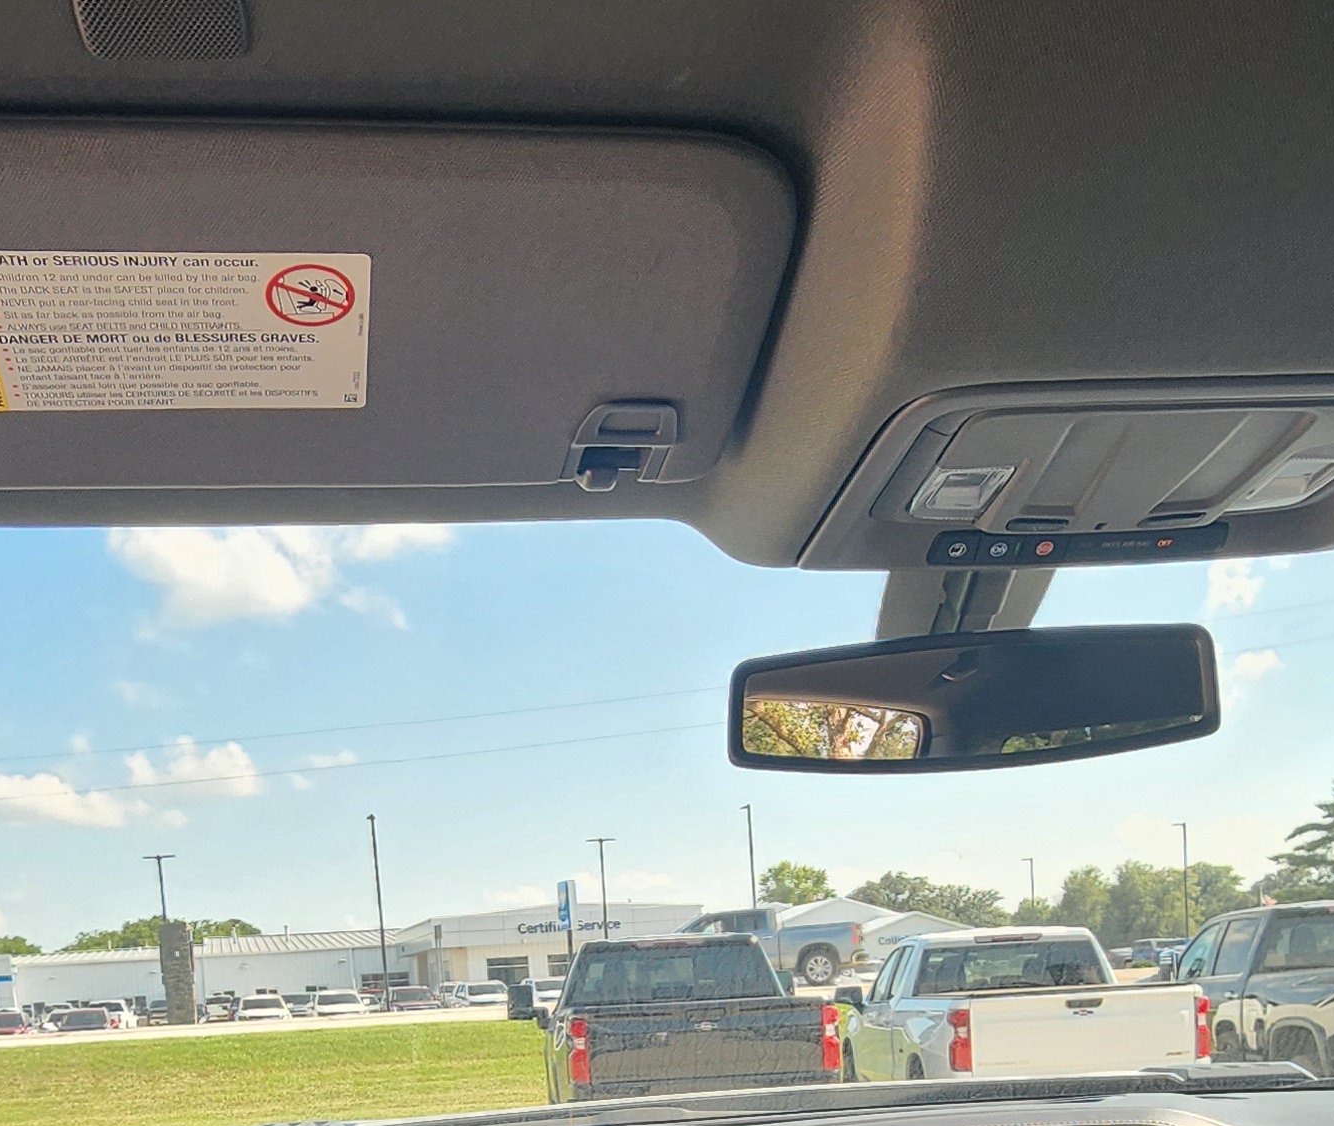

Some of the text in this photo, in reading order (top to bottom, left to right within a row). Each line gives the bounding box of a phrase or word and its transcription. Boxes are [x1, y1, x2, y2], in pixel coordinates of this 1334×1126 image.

[33, 257, 47, 267] or
[53, 255, 119, 267] SERIOUS
[124, 256, 178, 267] INJURY
[183, 259, 209, 267] can
[215, 259, 259, 267] occur.
[43, 273, 56, 282] 12
[60, 273, 79, 282] and
[83, 274, 113, 282] under
[139, 274, 151, 282] be
[155, 274, 183, 282] killed
[186, 274, 198, 284] by
[201, 274, 217, 282] the
[221, 274, 235, 282] air
[238, 274, 260, 284] bag.
[20, 286, 49, 294] BACK
[53, 286, 78, 294] SEAT
[82, 286, 91, 294] is
[95, 286, 111, 294] the
[115, 286, 153, 294] SAFEST
[157, 286, 184, 296] place
[187, 286, 202, 294] for
[205, 286, 248, 295] children.
[4, 311, 17, 319] Sit
[36, 311, 50, 319] far
[53, 311, 77, 319] back
[96, 311, 137, 321] possible
[203, 311, 224, 320] bag.
[63, 335, 83, 344] DE
[87, 334, 127, 344] MORT
[154, 334, 171, 343] de
[175, 334, 256, 343] BLESSURES
[261, 334, 319, 343] GRAVES.
[576, 919, 621, 931] Servce
